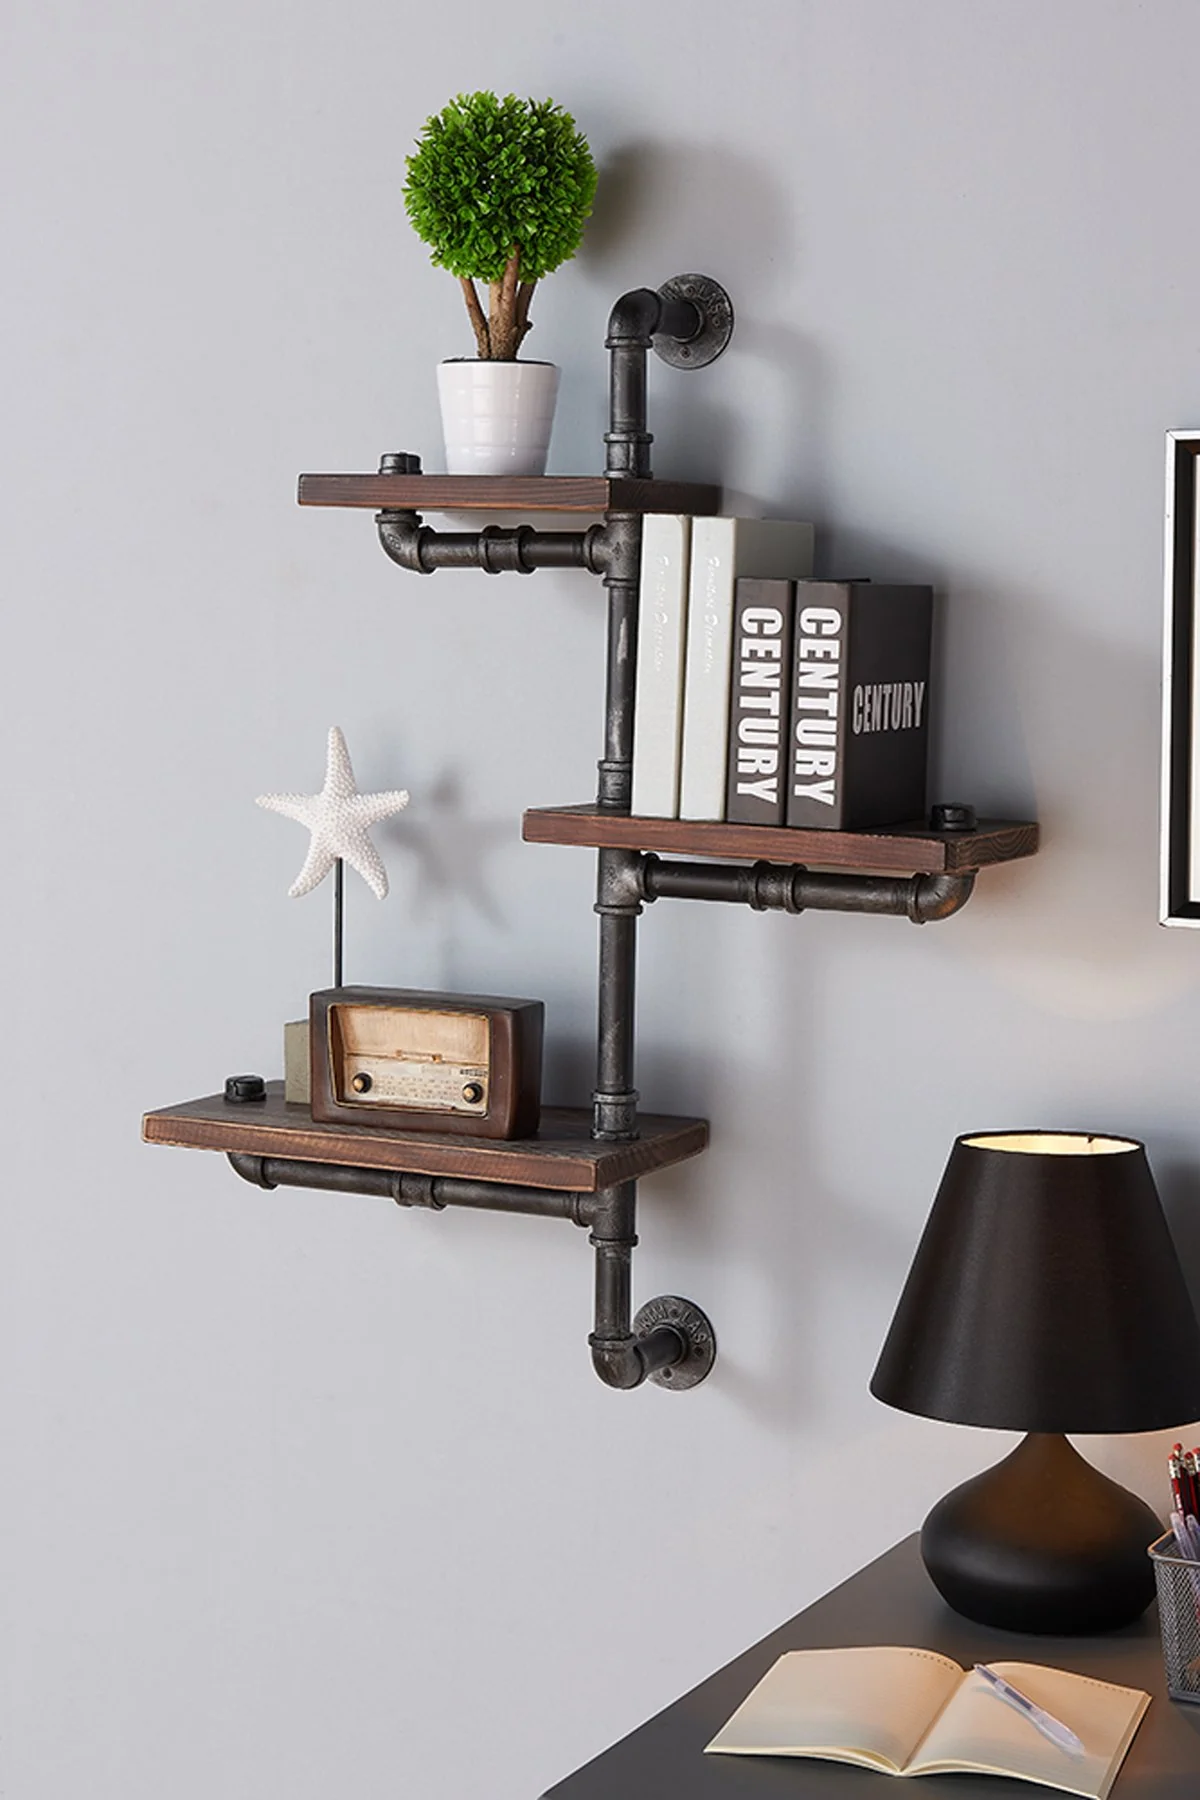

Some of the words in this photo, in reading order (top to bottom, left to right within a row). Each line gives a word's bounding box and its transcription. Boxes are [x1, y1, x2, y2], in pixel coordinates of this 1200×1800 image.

[736, 607, 783, 804] CENTURY
[793, 607, 843, 806] CENTURY
[852, 682, 926, 735] CENTURY
